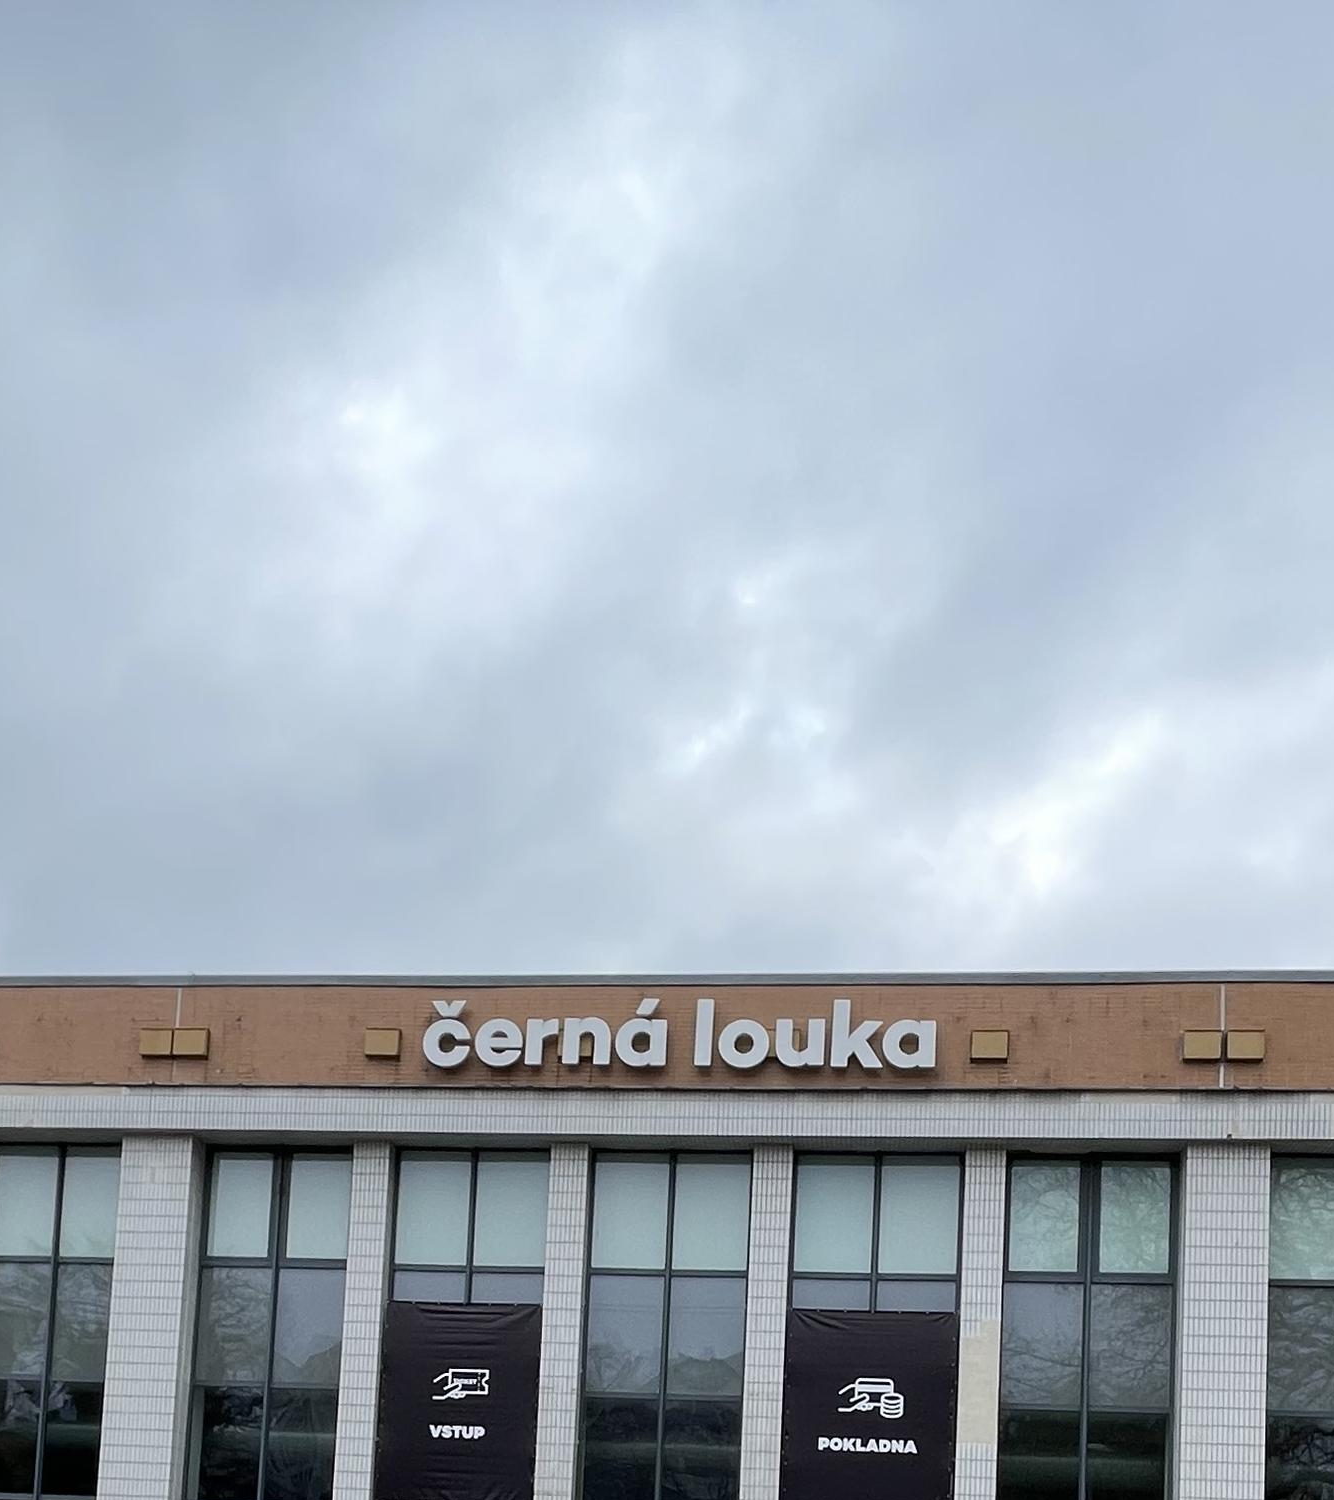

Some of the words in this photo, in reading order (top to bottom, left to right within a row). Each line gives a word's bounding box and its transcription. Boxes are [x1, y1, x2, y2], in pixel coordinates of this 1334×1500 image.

[422, 998, 667, 1068] černá
[693, 998, 937, 1068] louka
[429, 1424, 486, 1439] VSTUP
[817, 1437, 918, 1454] POKLADNA
